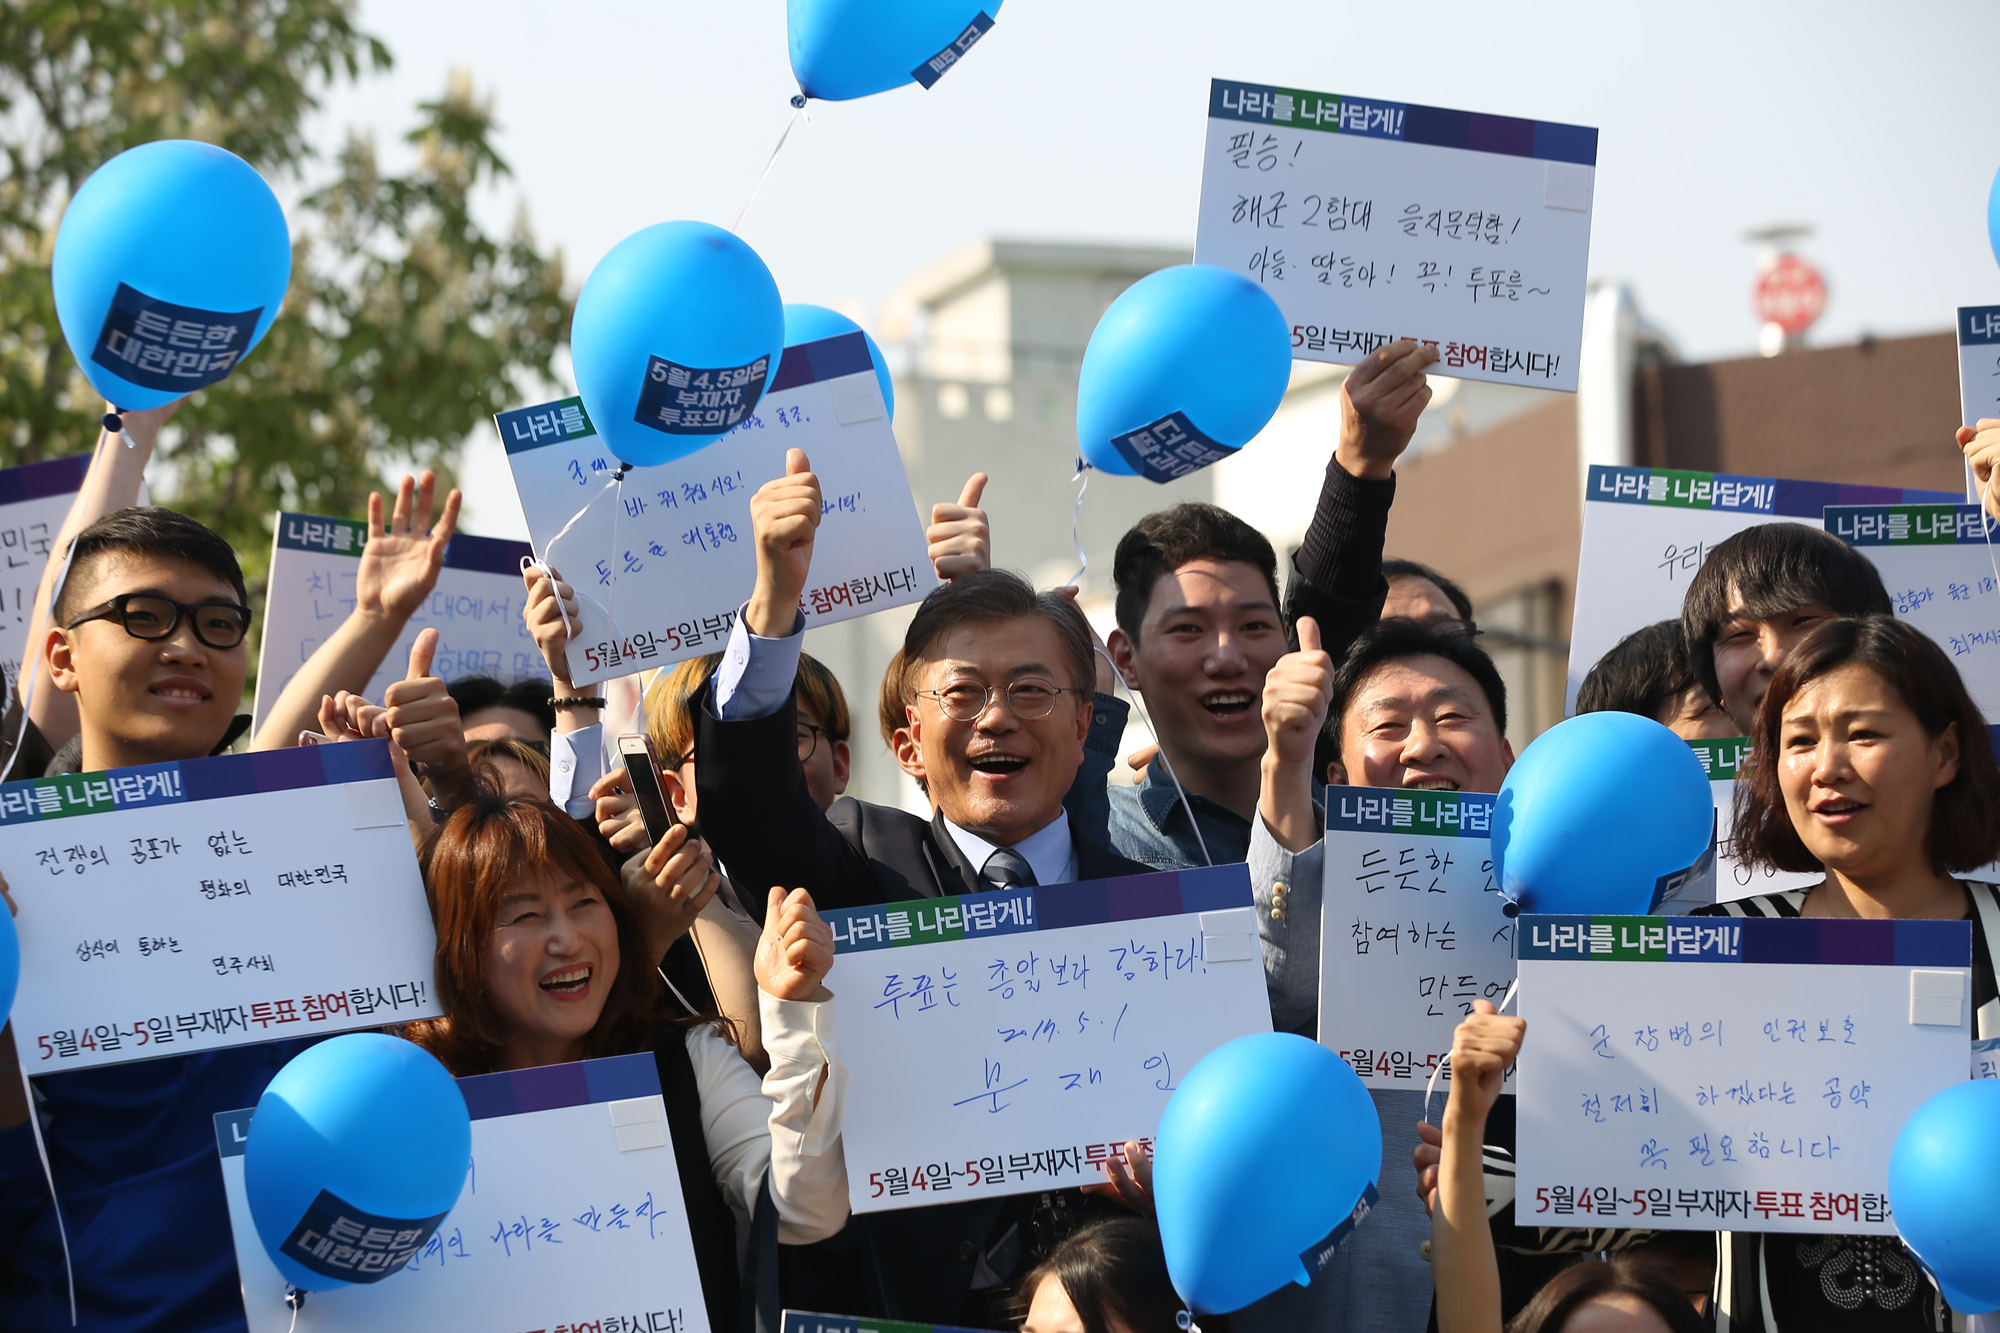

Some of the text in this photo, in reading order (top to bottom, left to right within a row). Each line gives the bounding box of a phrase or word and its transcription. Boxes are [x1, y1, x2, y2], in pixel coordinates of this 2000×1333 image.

[1222, 89, 1404, 135] 나라를 나라답게!
[1227, 131, 1302, 171] 필승!
[1232, 191, 1287, 229] 해군
[1417, 261, 1452, 293] 꼭!
[134, 309, 238, 349] 든든한
[651, 361, 690, 389] 5월
[676, 389, 741, 407] 부재자
[512, 404, 587, 442] 나라를
[1152, 418, 1187, 446] 더
[1600, 473, 1775, 510] 나라를 나라답게!
[288, 521, 354, 551] 나라를
[682, 523, 737, 552] 대통령
[1838, 512, 1998, 540] 나라를 나라답
[0, 522, 51, 569] 민국
[1658, 541, 1720, 580] 우리
[809, 566, 917, 615] 참여합시다!
[65, 770, 182, 808] 나라답게!
[1341, 796, 1415, 827] 나라를
[36, 830, 253, 876] 전쟁의 공포가 없는
[1356, 848, 1453, 893] 든든한
[199, 864, 349, 900] 평화의 대한민국
[830, 896, 1034, 946] 나라를 나라답게!
[1352, 916, 1455, 955] 참여하는
[1532, 923, 1741, 956] 나라를 나라답게!
[76, 940, 121, 962] 상식이
[873, 966, 961, 1020] 투표는
[1808, 1192, 1892, 1223] 참여합
[328, 1216, 423, 1250] 든든한
